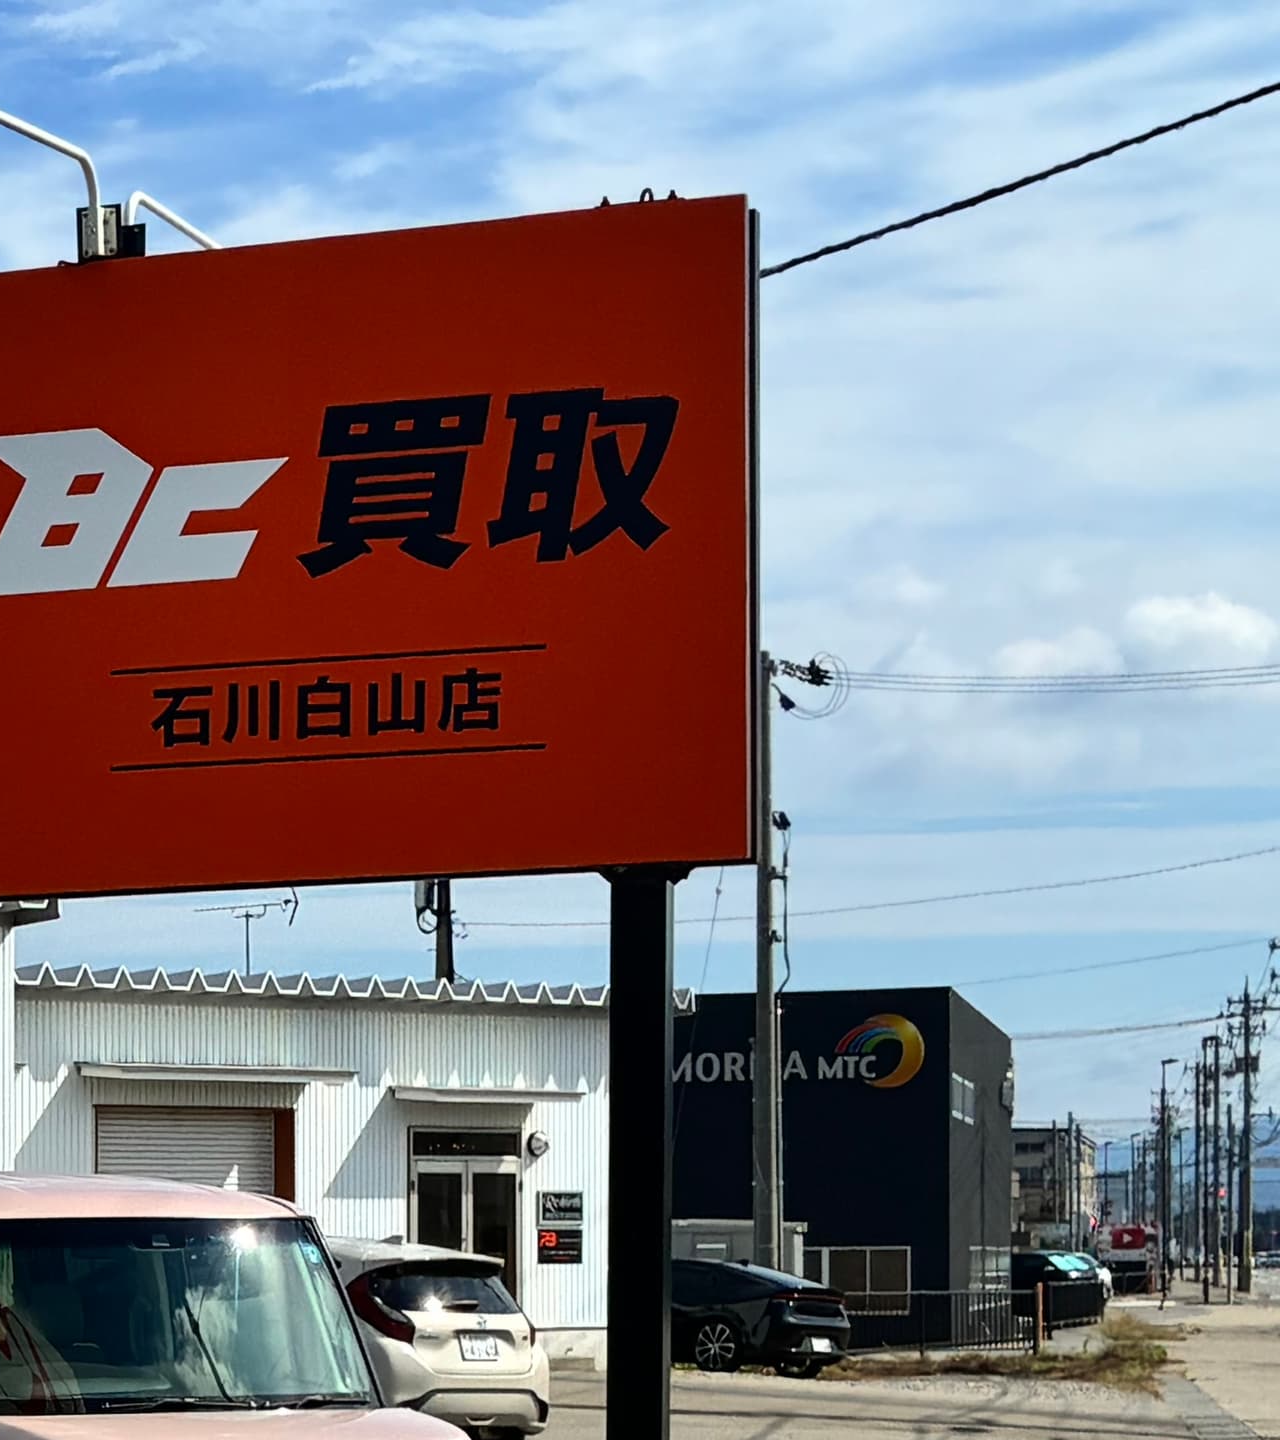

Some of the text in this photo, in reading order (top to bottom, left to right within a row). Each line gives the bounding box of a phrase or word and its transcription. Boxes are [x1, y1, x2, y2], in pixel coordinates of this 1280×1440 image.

[296, 387, 680, 578] 買取
[151, 667, 503, 748] 石川白山店
[671, 1050, 878, 1083] MORIA MTC
